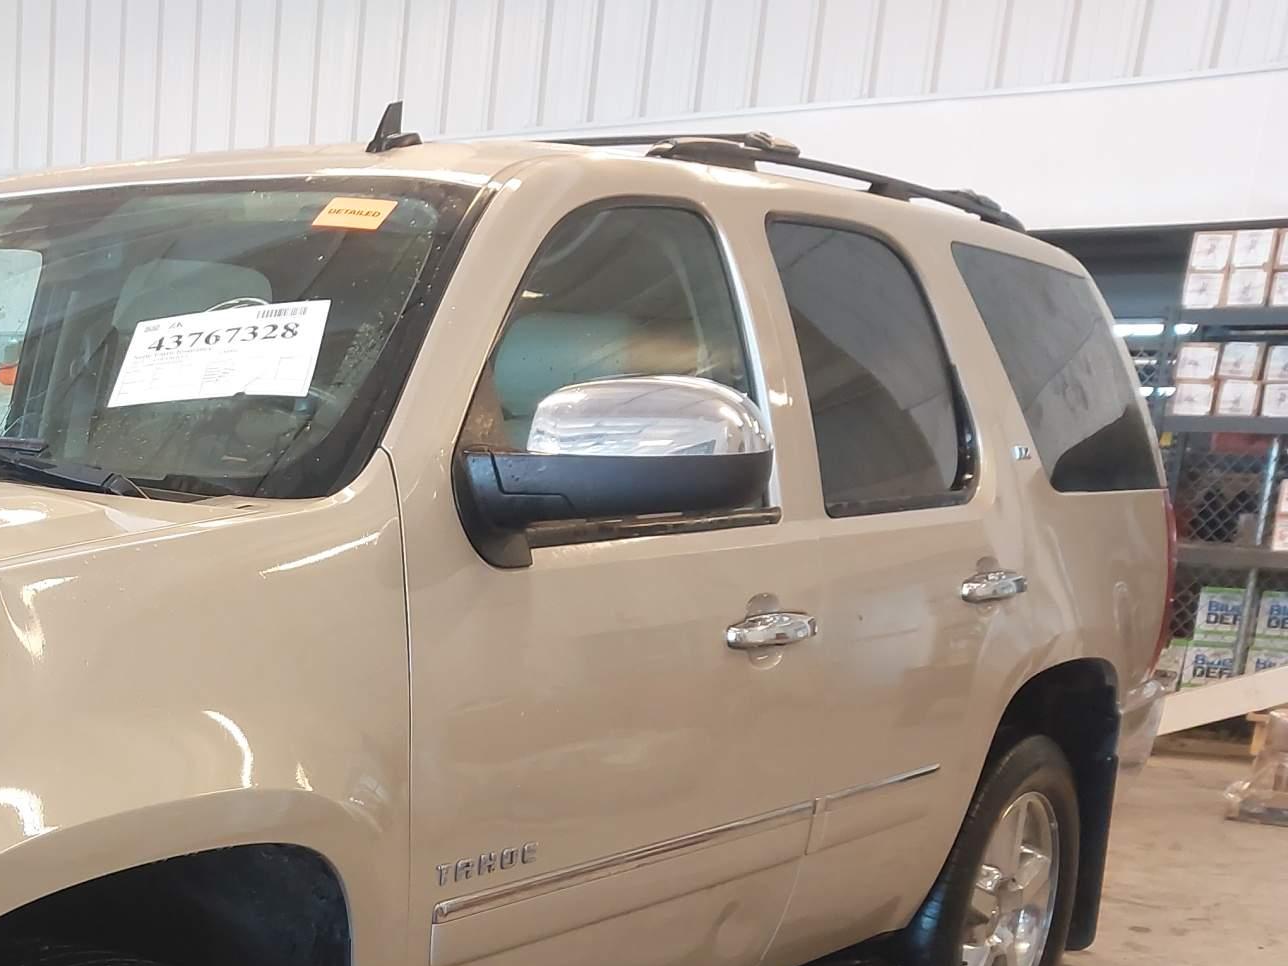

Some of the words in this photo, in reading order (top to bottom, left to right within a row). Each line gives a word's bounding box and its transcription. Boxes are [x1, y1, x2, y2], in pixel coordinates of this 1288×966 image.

[327, 208, 381, 217] DETAILED
[147, 321, 300, 351] 43767328
[436, 842, 539, 887] TAHOE
